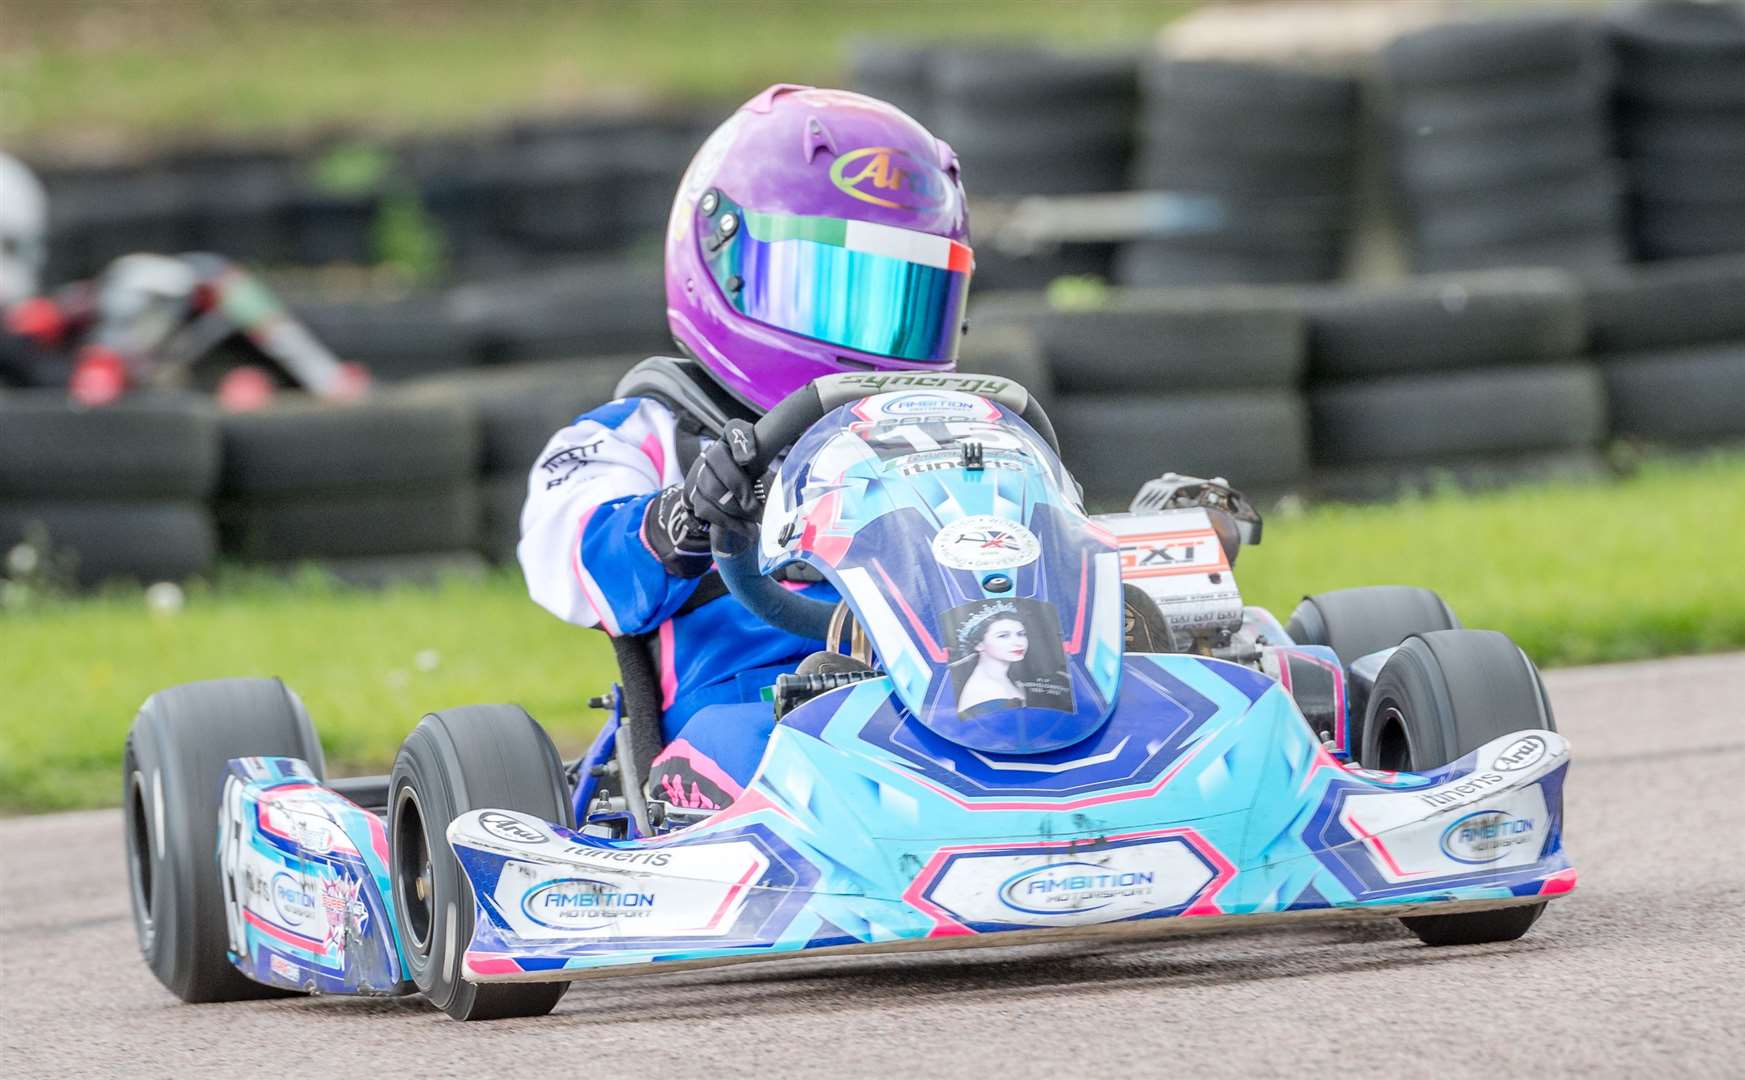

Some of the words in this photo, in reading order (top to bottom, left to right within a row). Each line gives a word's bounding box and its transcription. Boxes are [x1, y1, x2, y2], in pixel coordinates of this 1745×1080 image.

[898, 399, 974, 410] AMBITION
[1458, 818, 1536, 843] AMBITION
[1027, 871, 1154, 895] AMBITION
[544, 893, 656, 908] AMBITION
[559, 909, 652, 918] MOTORSPORT
